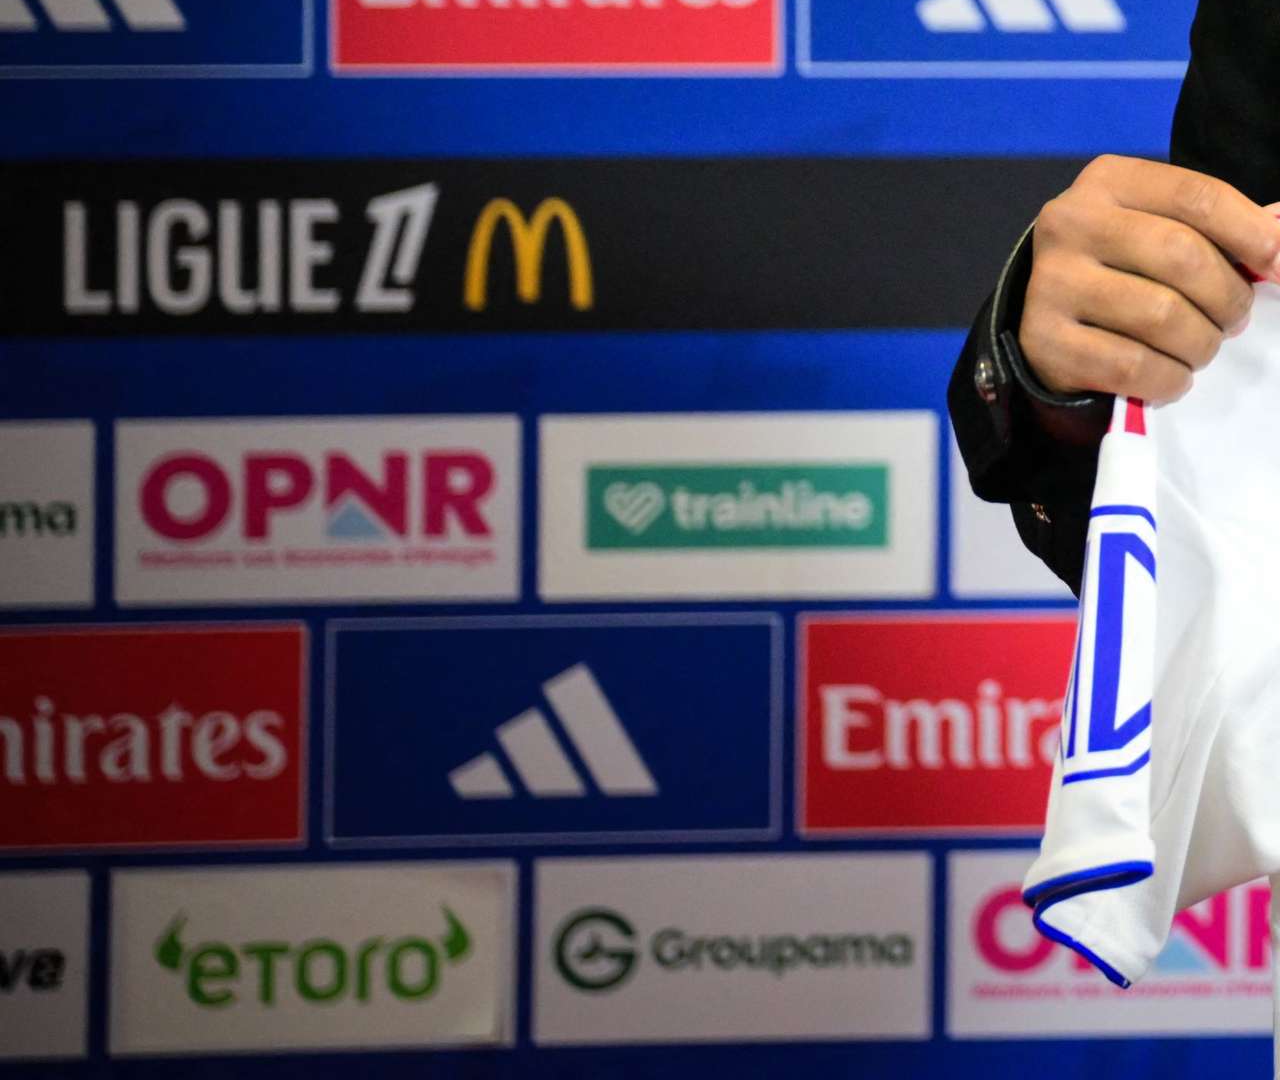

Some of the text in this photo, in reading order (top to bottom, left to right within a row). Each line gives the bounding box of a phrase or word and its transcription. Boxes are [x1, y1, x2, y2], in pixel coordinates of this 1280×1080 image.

[64, 198, 341, 314] LIGUE
[138, 449, 496, 541] OPNR
[671, 480, 876, 532] trainline
[0, 697, 287, 783] irates
[650, 926, 914, 977] Groupama
